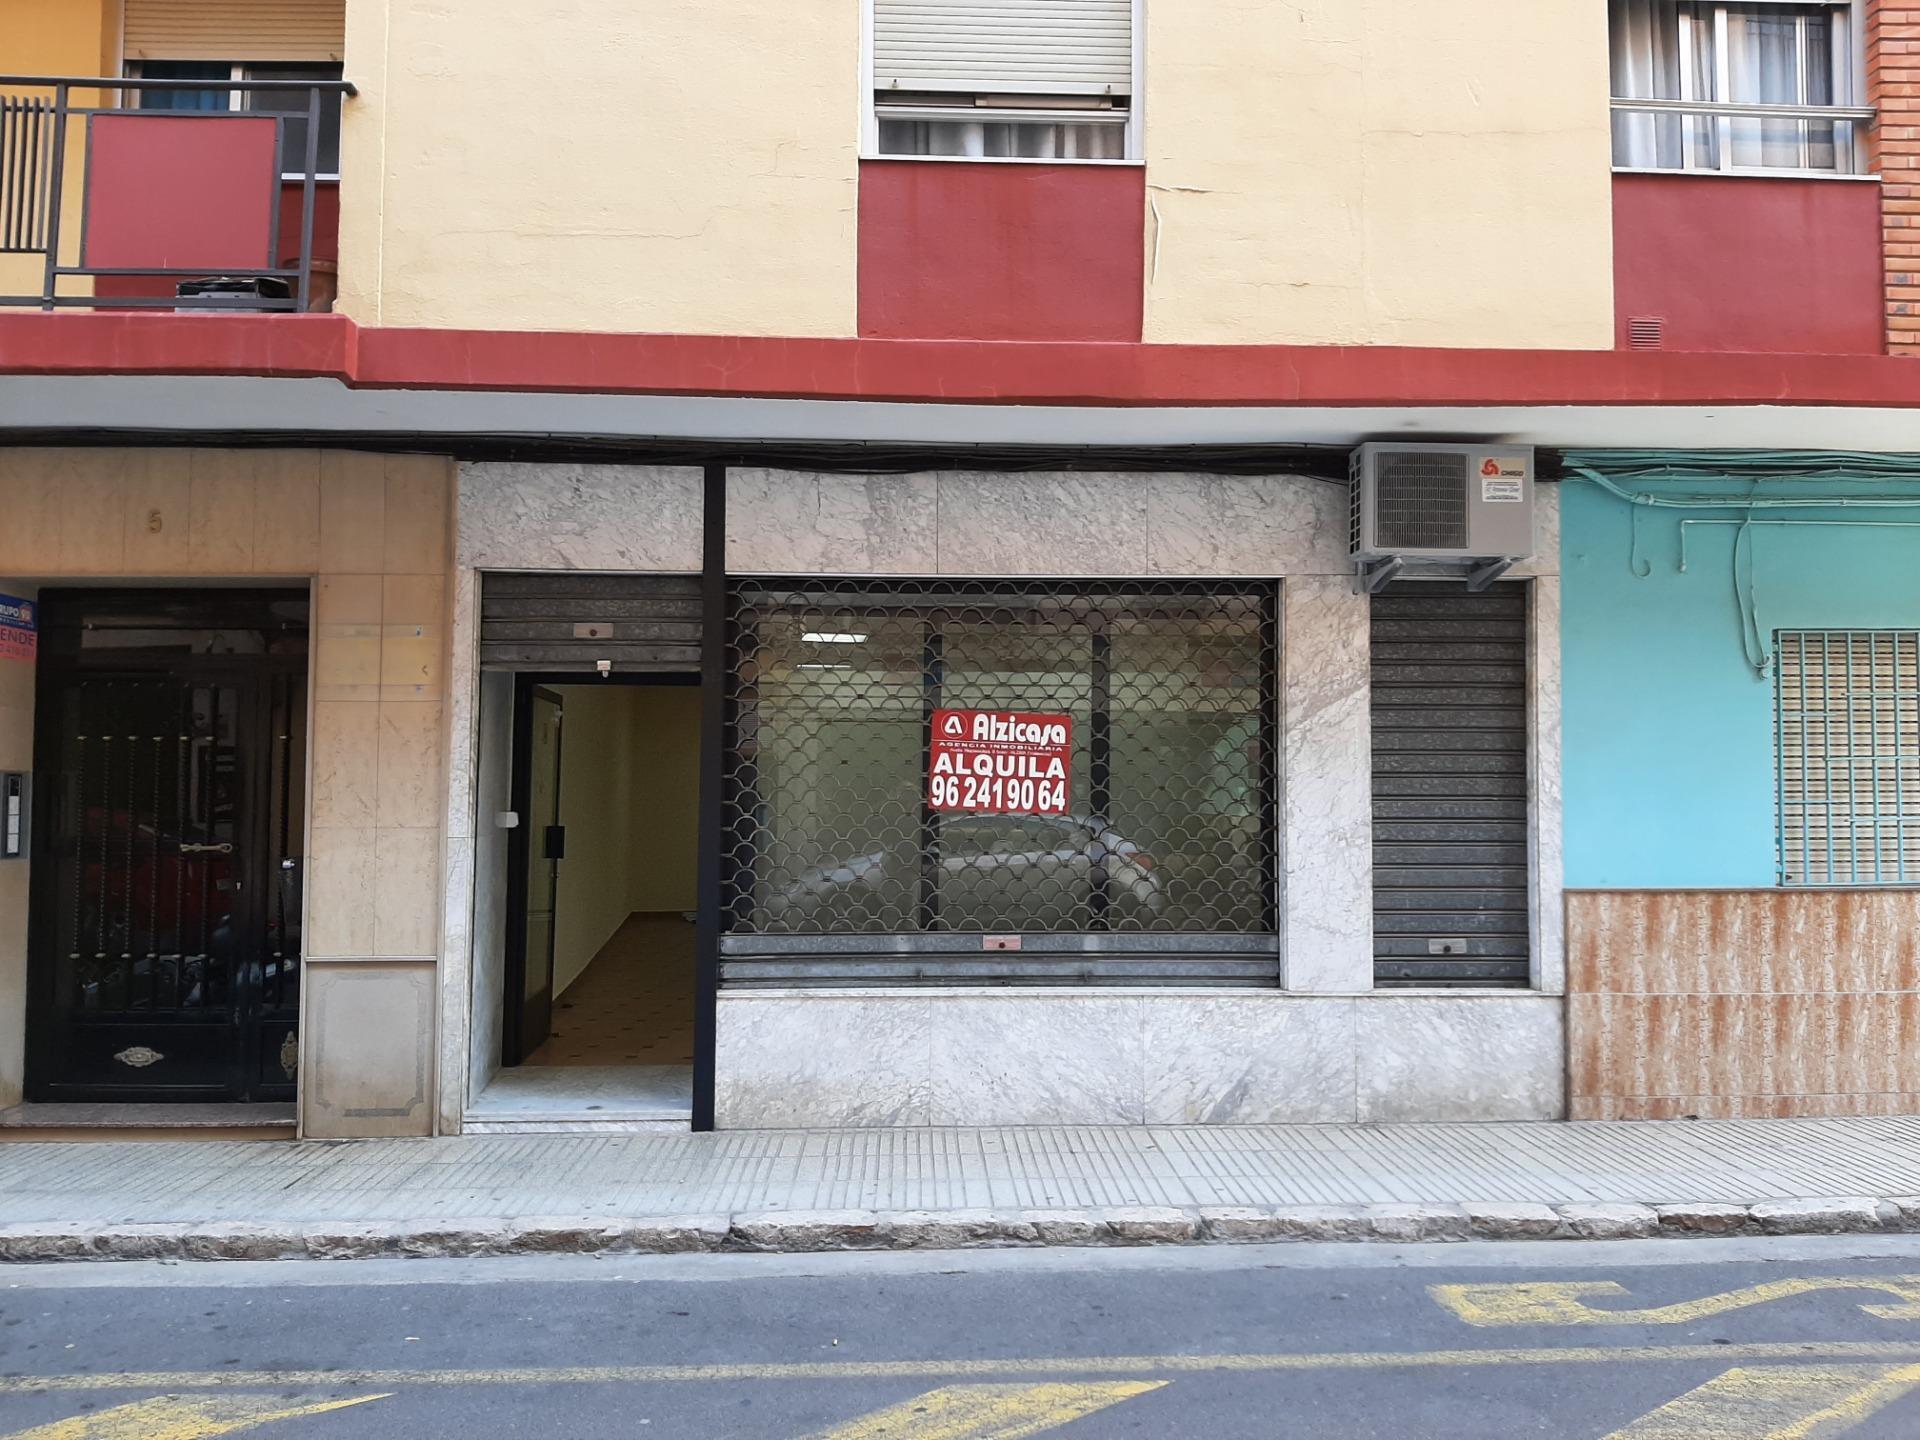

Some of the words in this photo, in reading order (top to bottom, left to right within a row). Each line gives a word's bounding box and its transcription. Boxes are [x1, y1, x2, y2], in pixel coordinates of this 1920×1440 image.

[149, 509, 162, 534] 5
[973, 713, 1067, 746] Alzicasa
[990, 744, 1063, 752] INMOBILIARIA
[933, 752, 1066, 779] ALQUILA
